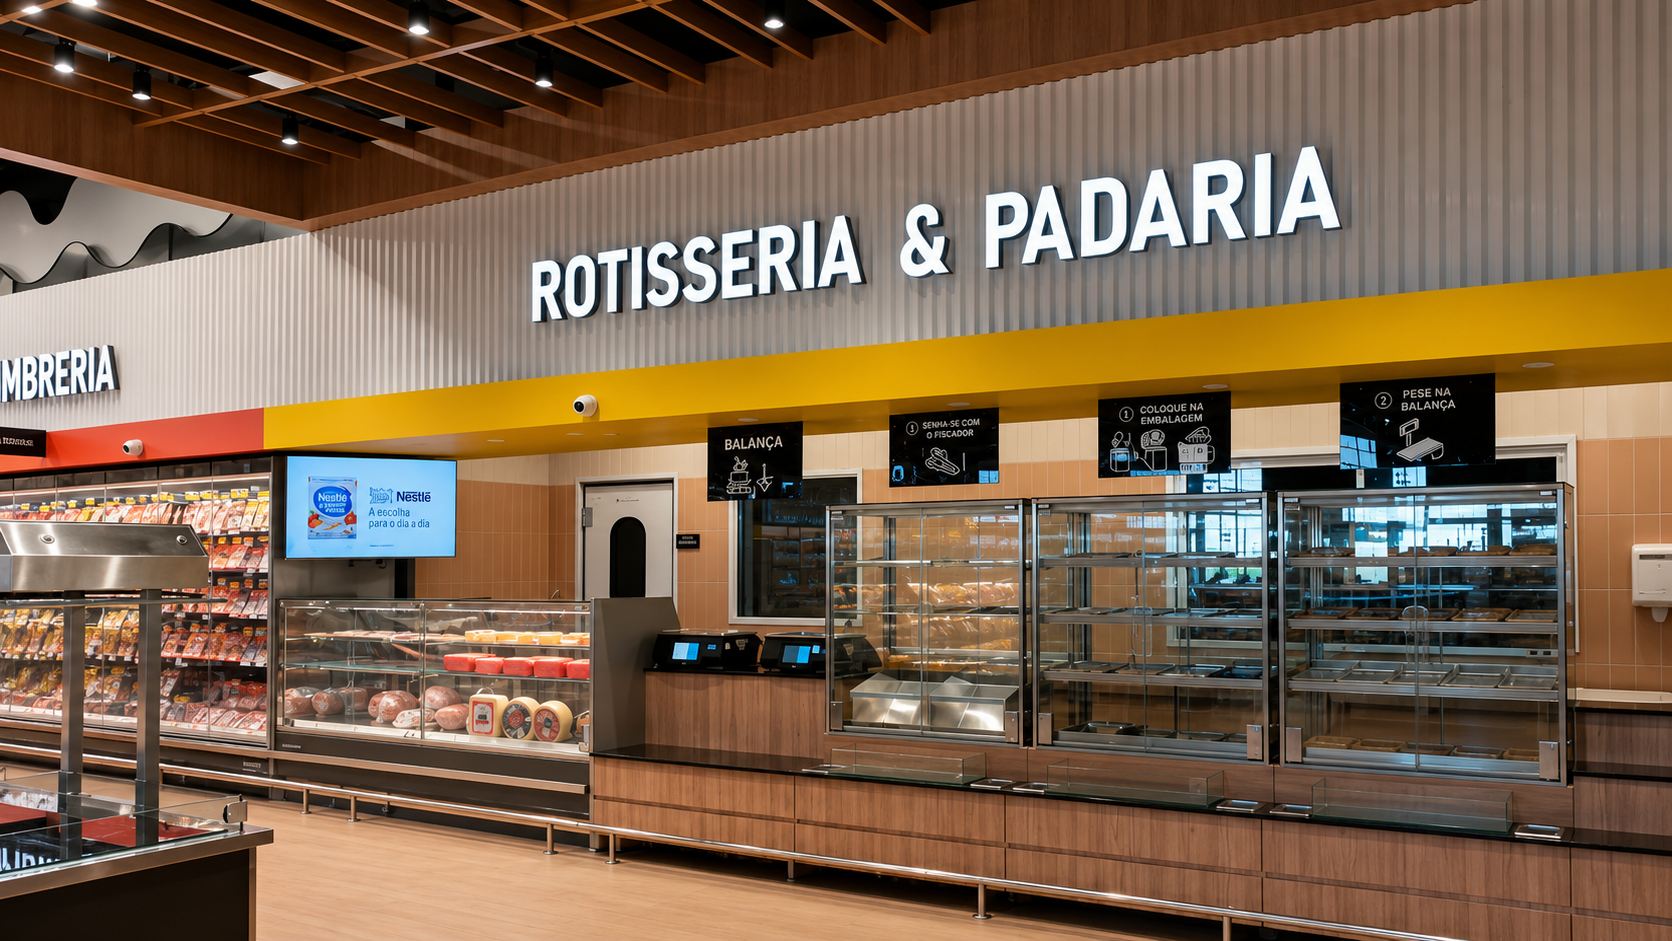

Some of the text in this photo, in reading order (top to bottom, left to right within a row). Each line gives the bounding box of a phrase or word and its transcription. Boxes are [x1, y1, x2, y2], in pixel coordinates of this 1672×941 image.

[531, 146, 1342, 323] ROTISSERIA & PADARIA
[1403, 387, 1451, 399] PESE NA
[1140, 402, 1204, 414] COLOQUE NA
[1401, 399, 1456, 412] BALANÇA
[961, 418, 981, 427] COM
[1140, 413, 1203, 425] EMBALAGEM
[926, 428, 974, 440] O FISCADOR
[724, 435, 783, 451] BALANÇA
[368, 507, 375, 517] A
[368, 520, 388, 530] para
[389, 520, 395, 528] o
[410, 520, 416, 528] a
[417, 519, 430, 528] dia
